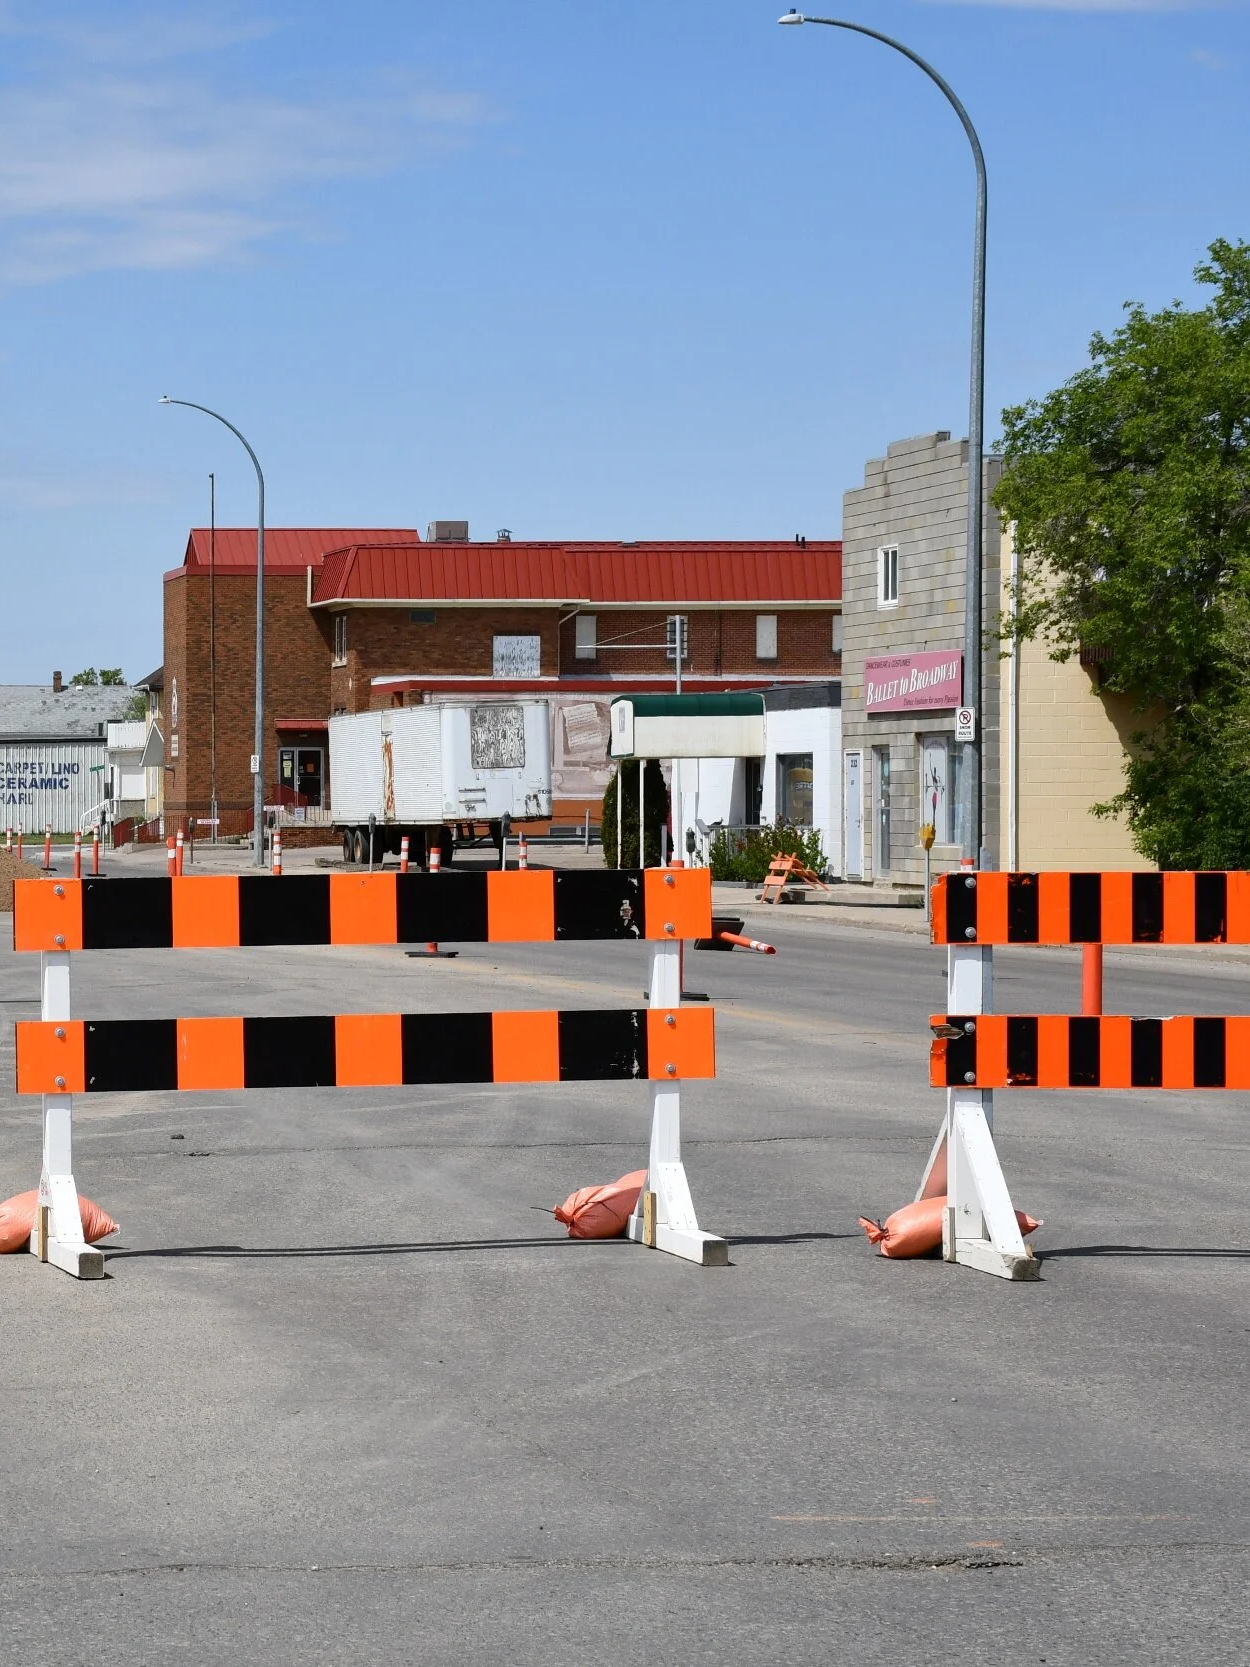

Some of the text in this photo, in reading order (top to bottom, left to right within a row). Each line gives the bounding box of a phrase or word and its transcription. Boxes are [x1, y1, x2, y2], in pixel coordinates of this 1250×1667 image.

[866, 660, 959, 706] BALLET to BROADWAY
